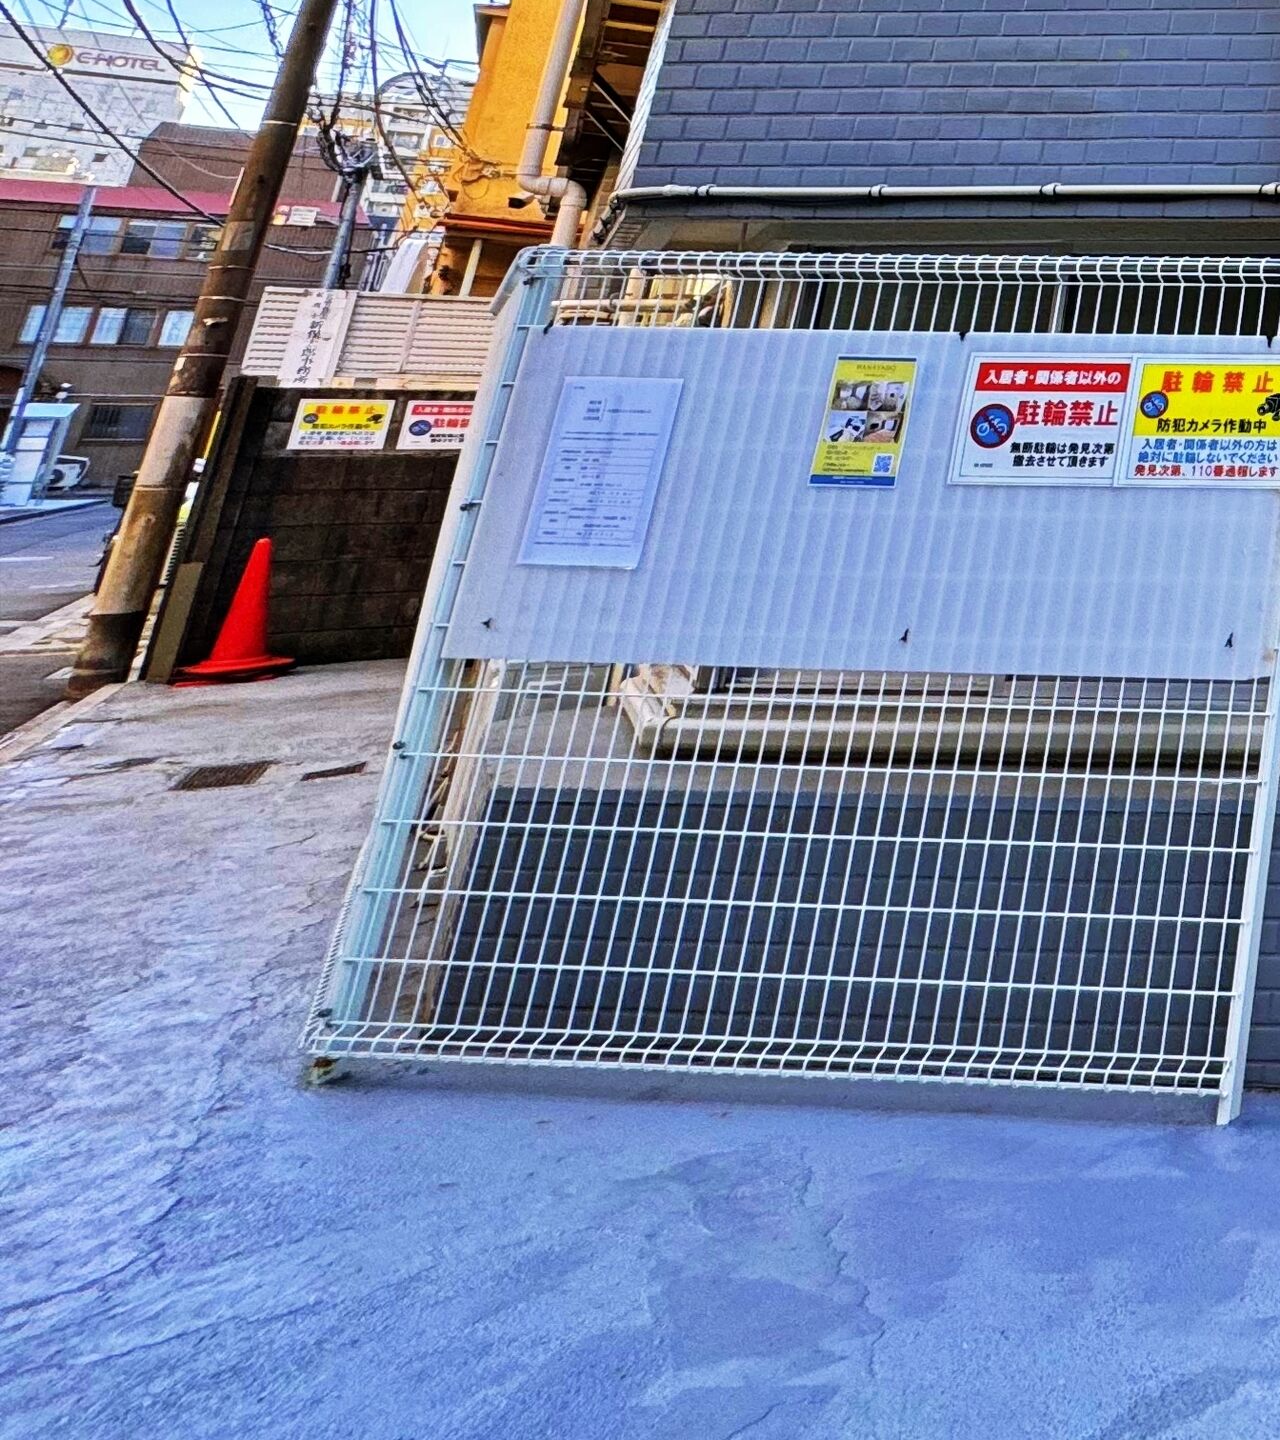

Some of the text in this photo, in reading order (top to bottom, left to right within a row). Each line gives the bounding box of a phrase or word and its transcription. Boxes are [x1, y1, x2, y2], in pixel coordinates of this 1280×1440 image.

[983, 369, 1122, 386] 入居者・関係者以外の
[1160, 371, 1275, 393] 駐輪禁止
[1014, 400, 1119, 426] 駐輪禁止
[1156, 418, 1267, 433] 防犯カメラ作動中
[1009, 442, 1116, 454] 無断駐輪は発見次第
[1141, 438, 1278, 451] 入居者・関係者以外の方は
